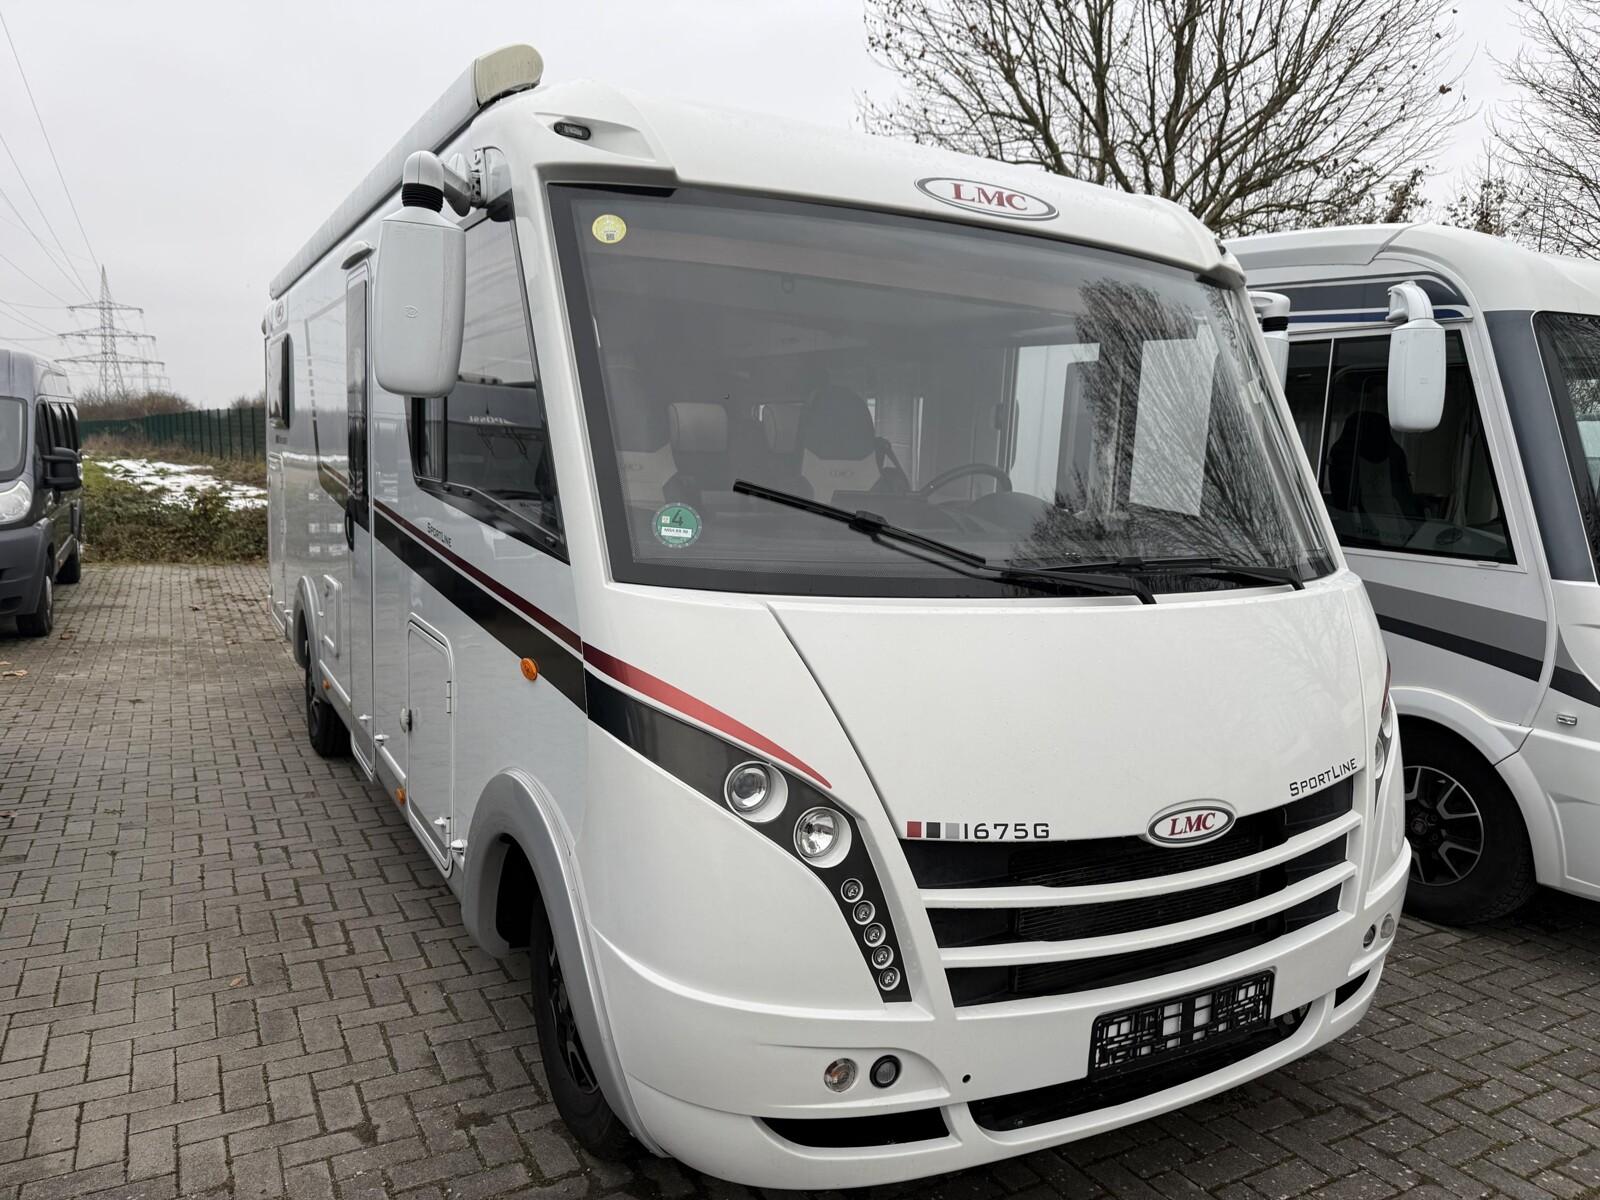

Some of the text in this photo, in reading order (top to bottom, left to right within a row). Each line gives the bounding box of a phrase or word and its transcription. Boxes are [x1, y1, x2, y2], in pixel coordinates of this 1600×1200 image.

[951, 183, 1028, 211] LMC
[671, 509, 684, 527] 4
[1168, 812, 1216, 836] LMC
